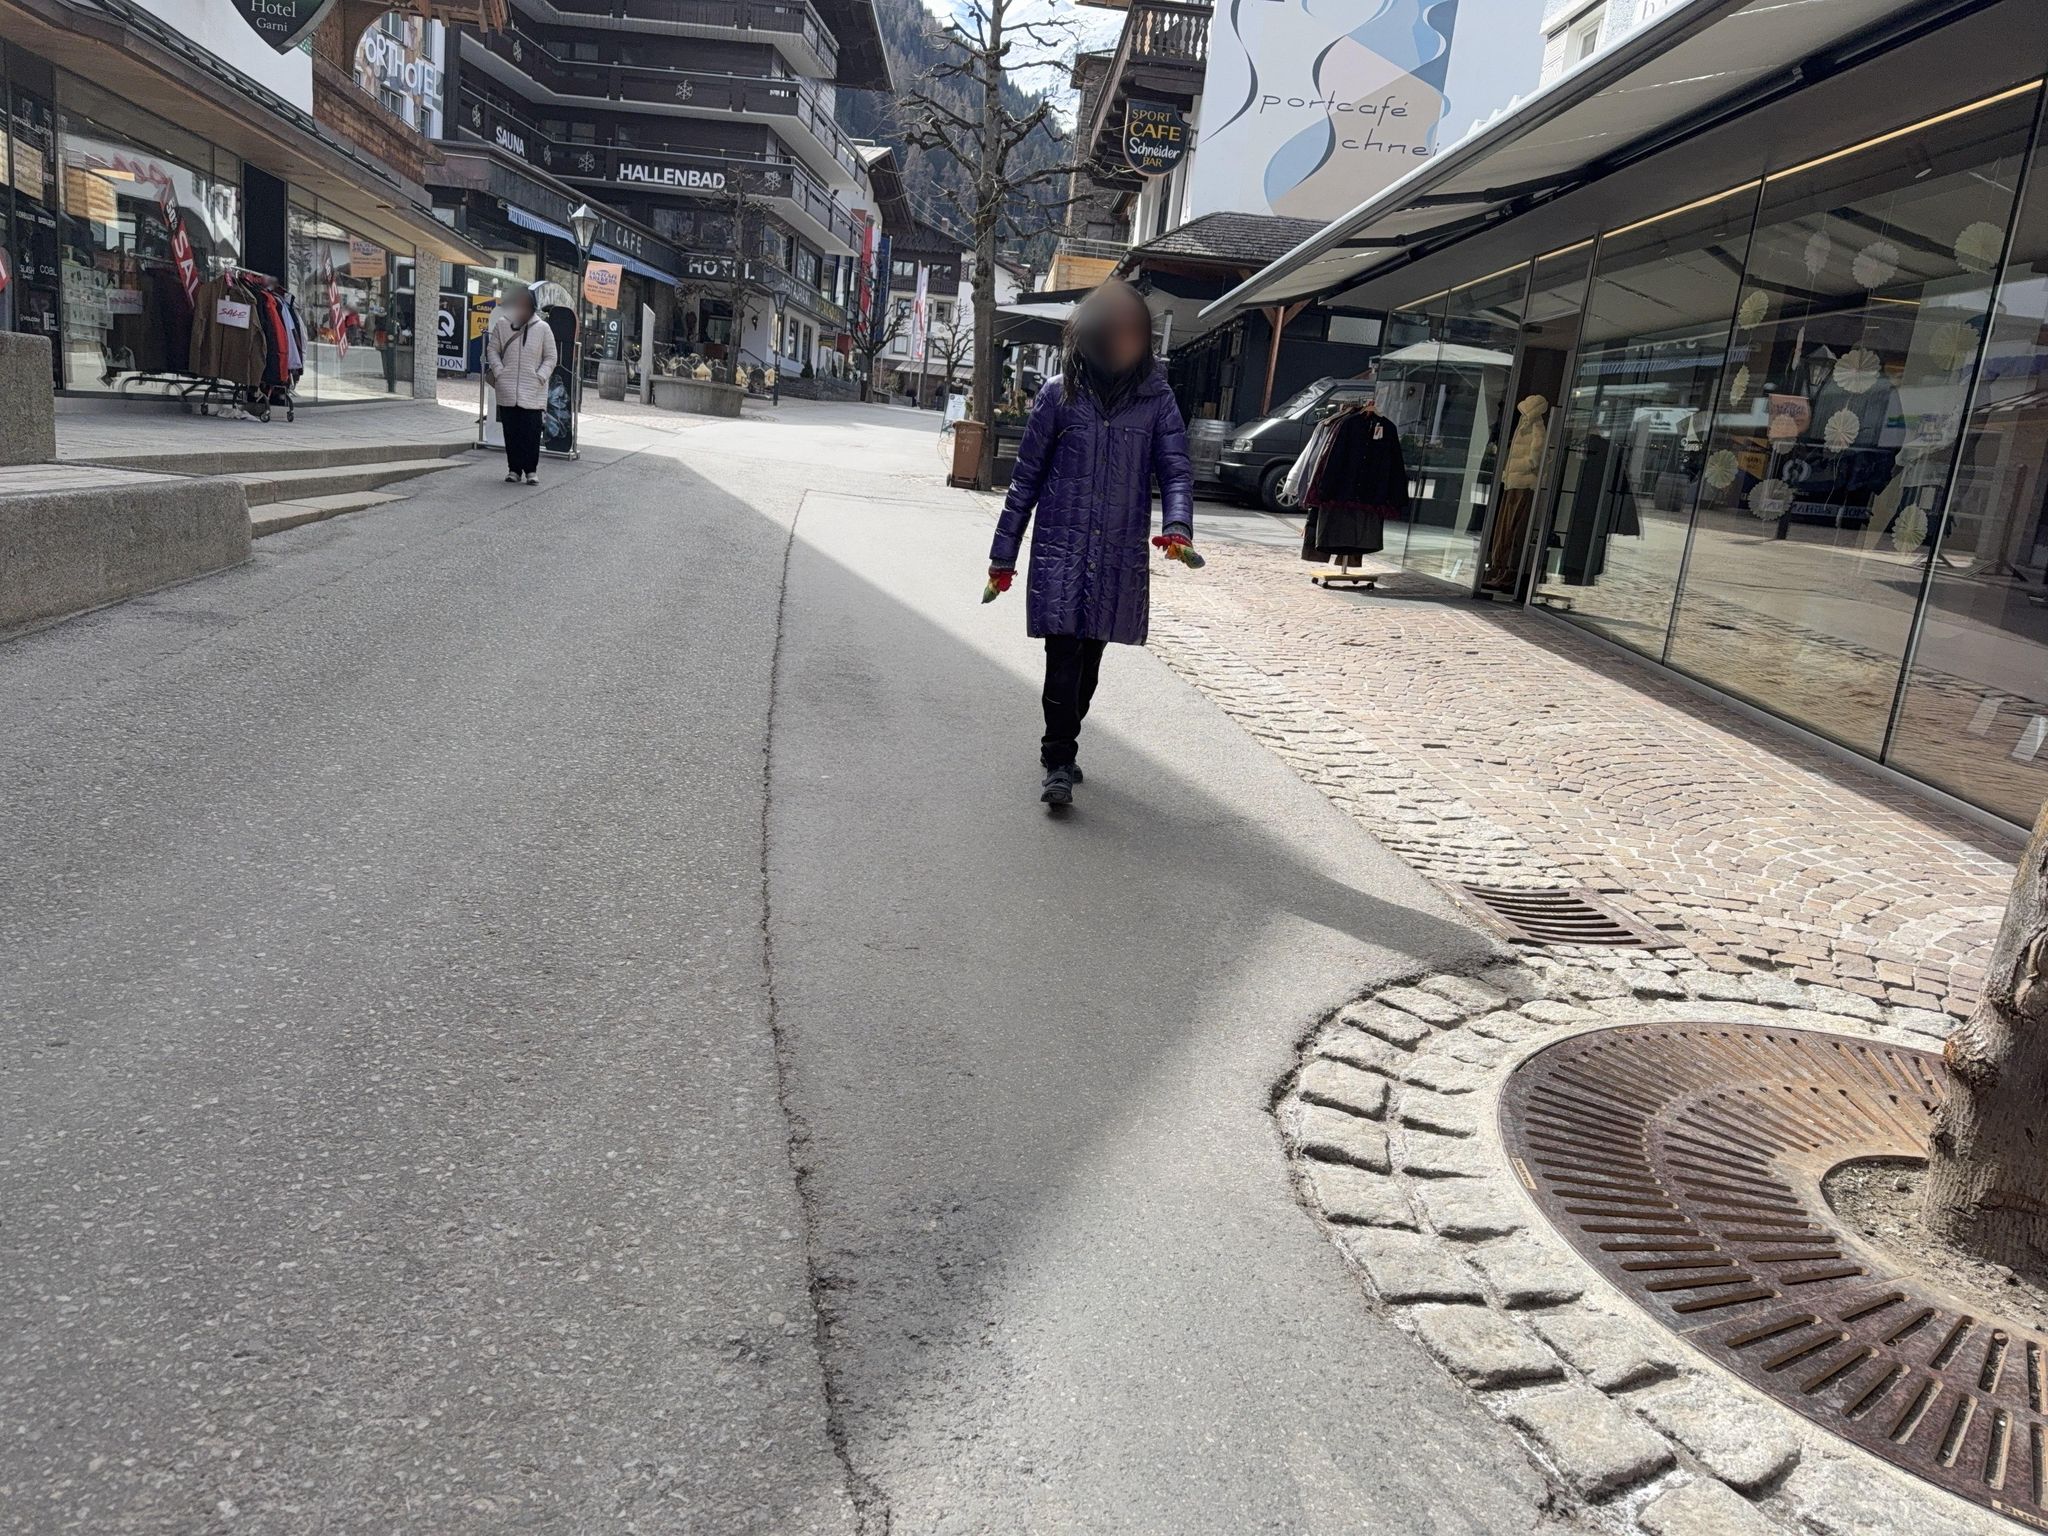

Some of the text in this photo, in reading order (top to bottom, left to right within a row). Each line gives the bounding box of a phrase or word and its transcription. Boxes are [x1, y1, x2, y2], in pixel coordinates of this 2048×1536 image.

[251, 0, 296, 18] Hotel
[256, 18, 288, 32] Garni
[364, 34, 443, 99] ORTHOTEL
[1132, 109, 1172, 122] SPORT
[495, 126, 525, 158] SAUNA
[1130, 121, 1181, 142] CAFE
[1129, 137, 1180, 159] Schneider
[1143, 157, 1162, 167] BAR
[619, 163, 726, 189] HALLENBAD
[615, 228, 642, 254] CAFE
[173, 230, 198, 308] SAL
